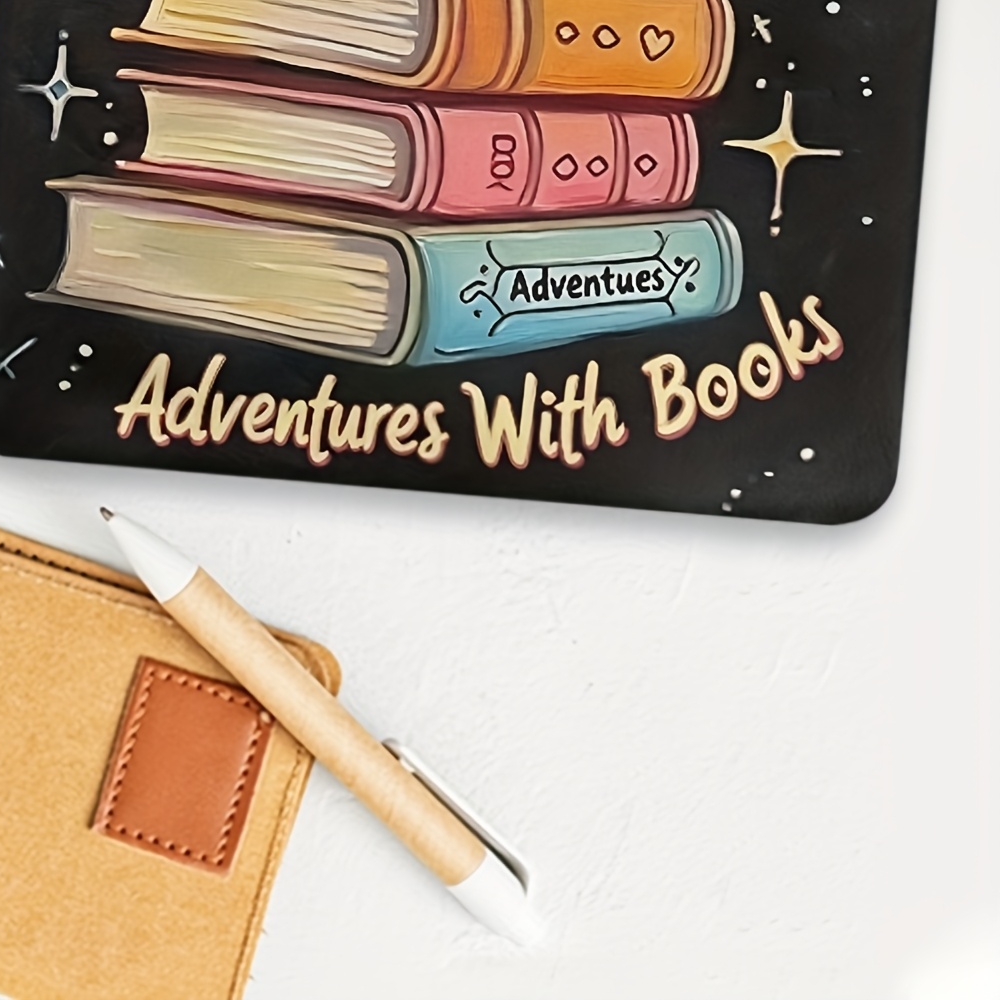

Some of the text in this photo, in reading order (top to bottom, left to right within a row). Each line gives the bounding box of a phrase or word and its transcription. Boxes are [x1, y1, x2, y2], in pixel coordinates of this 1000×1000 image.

[510, 265, 665, 303] Adventues
[115, 291, 846, 469] Adventures With Books
